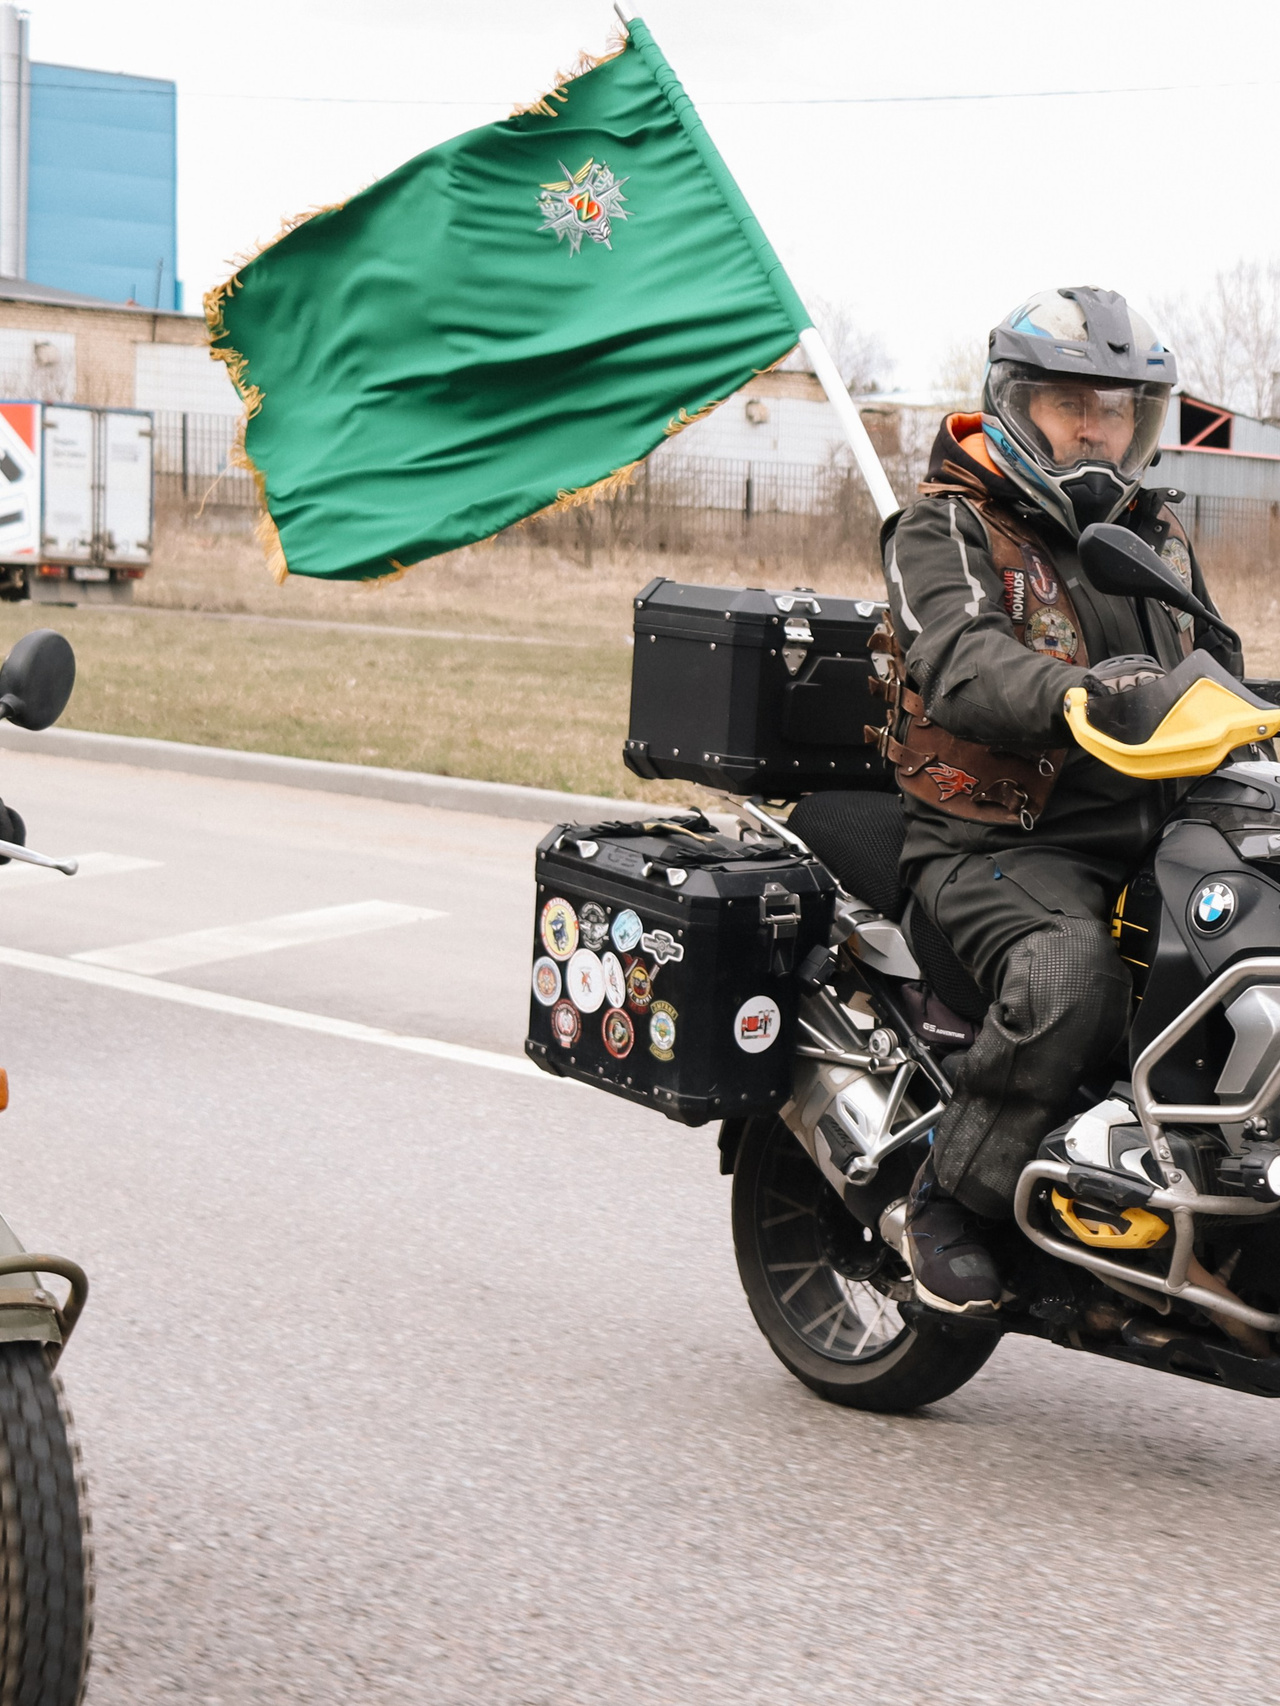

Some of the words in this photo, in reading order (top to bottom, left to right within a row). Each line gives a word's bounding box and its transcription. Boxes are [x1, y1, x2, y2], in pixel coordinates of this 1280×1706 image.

[1012, 571, 1025, 620] NOMADS
[922, 1022, 937, 1033] GS
[936, 1028, 966, 1039] ADVENTURE
